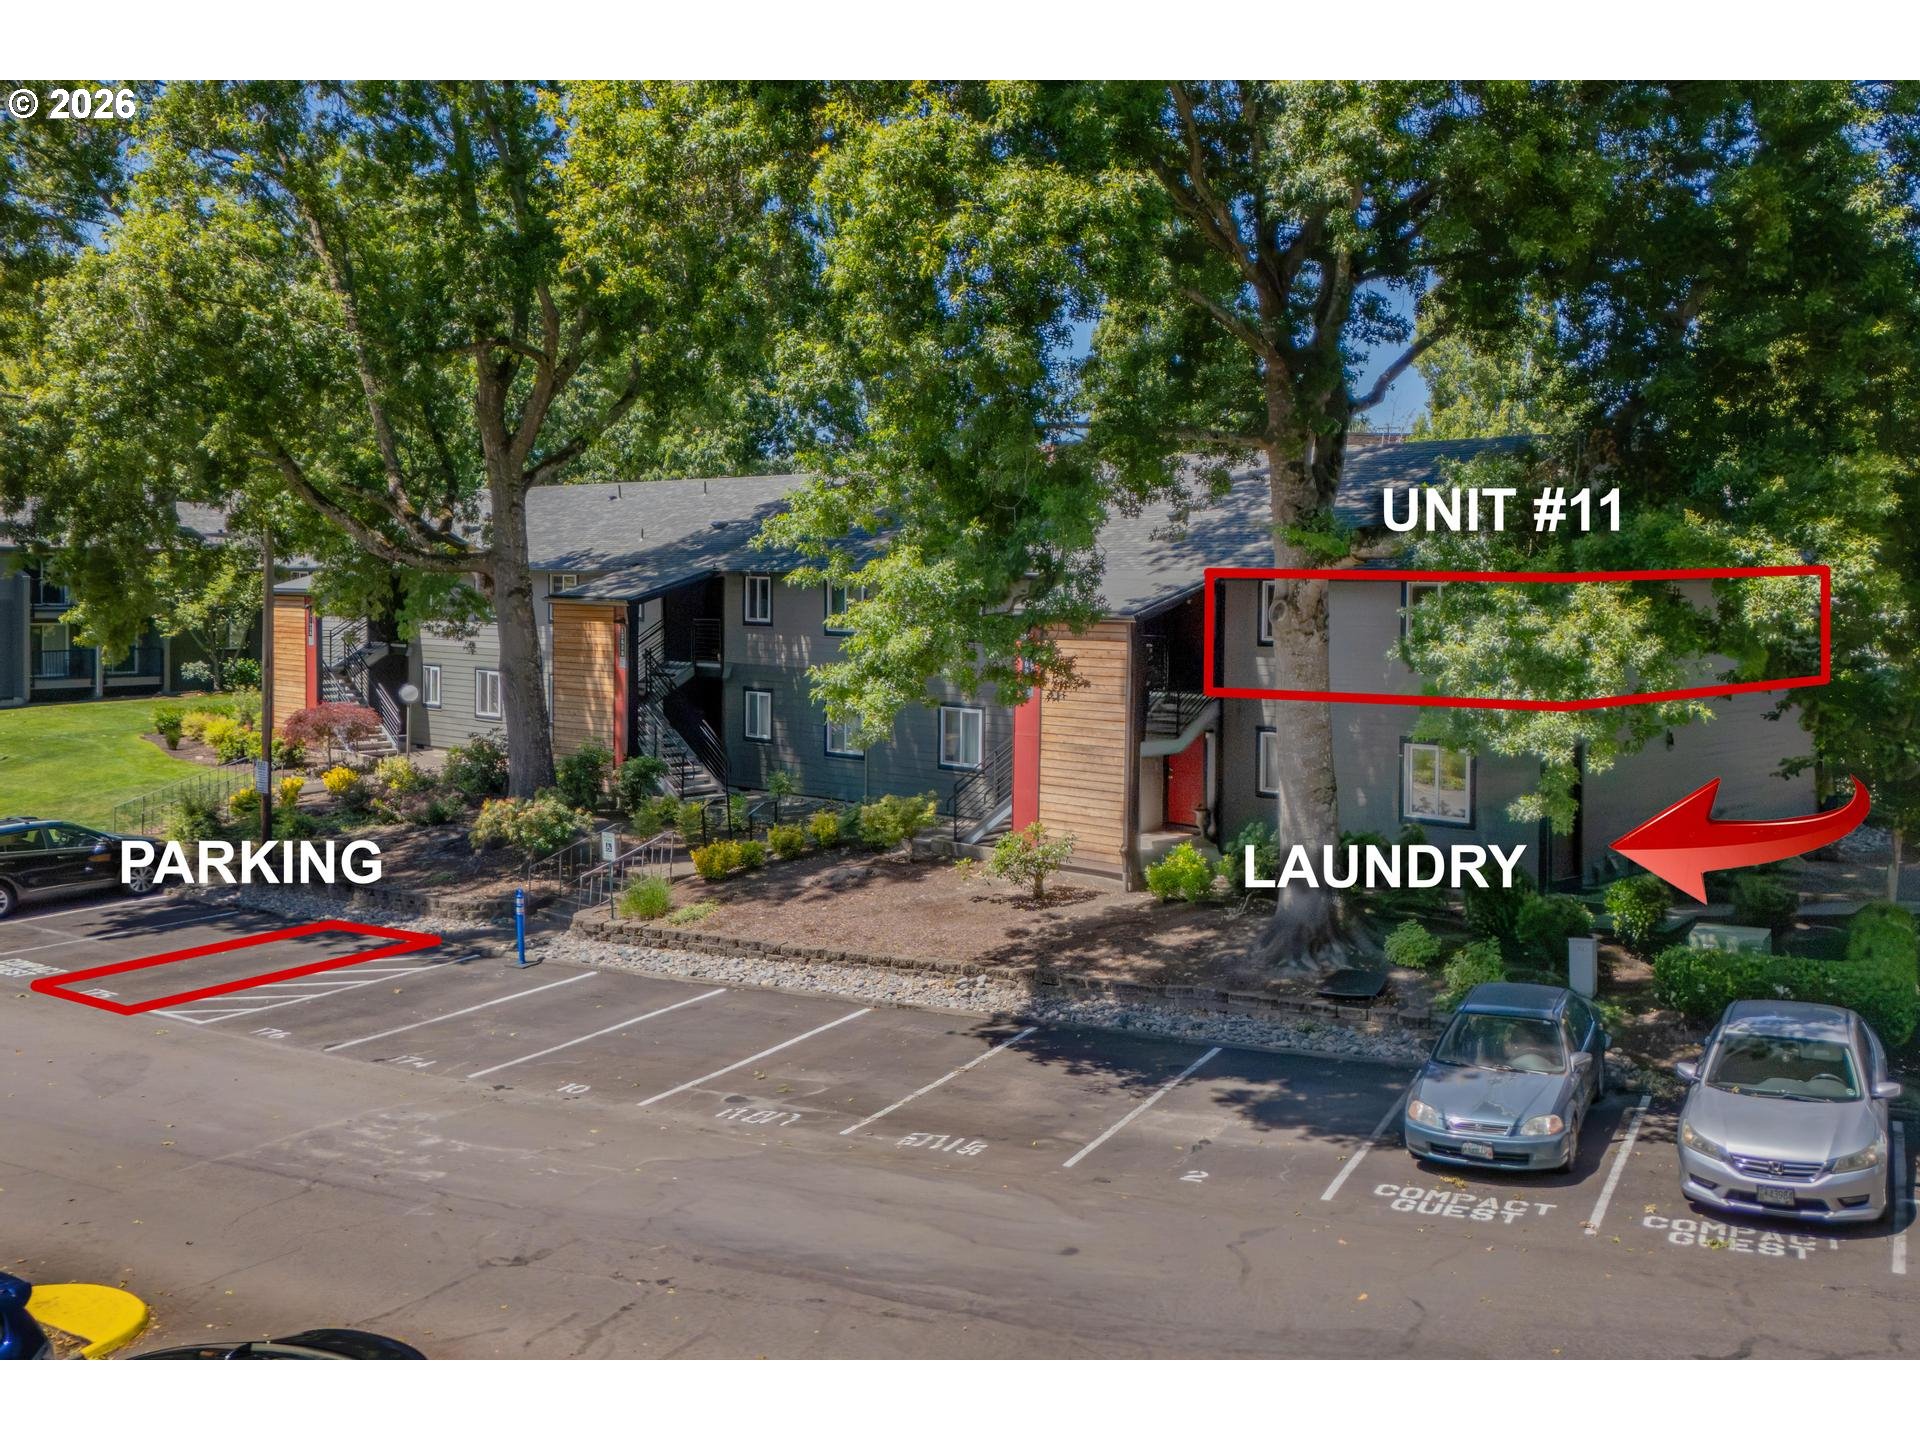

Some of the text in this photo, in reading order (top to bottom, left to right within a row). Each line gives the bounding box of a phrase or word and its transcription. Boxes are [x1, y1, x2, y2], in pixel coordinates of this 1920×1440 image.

[557, 1082, 591, 1094] 10
[1179, 1170, 1209, 1183] 2
[1374, 1184, 1557, 1215] COMPACT
[1390, 1198, 1524, 1224] GUEST
[1668, 1231, 1816, 1259] GUEST
